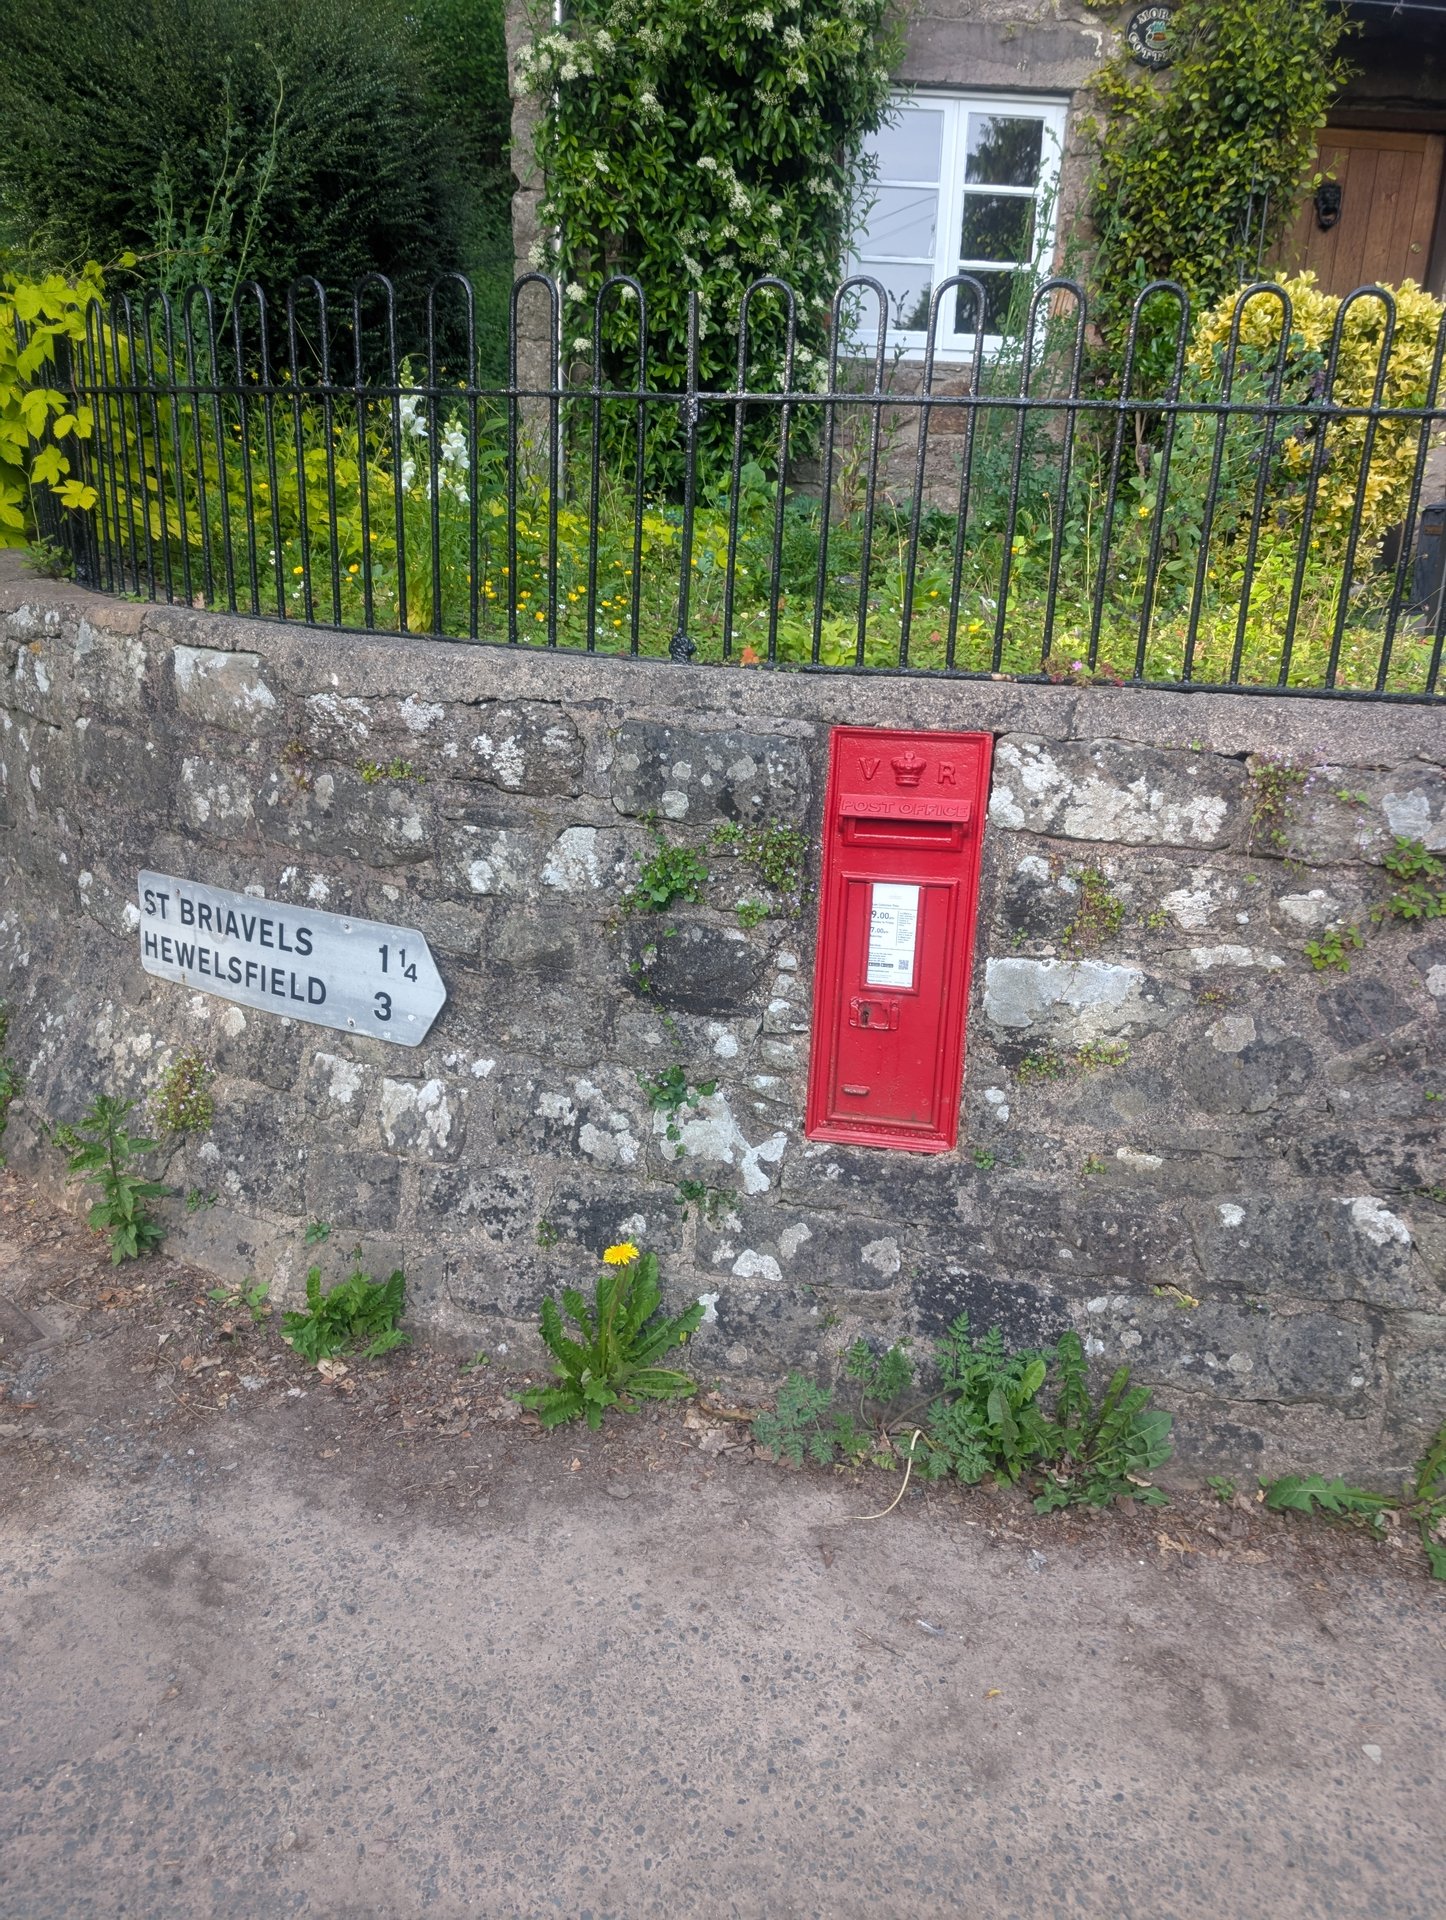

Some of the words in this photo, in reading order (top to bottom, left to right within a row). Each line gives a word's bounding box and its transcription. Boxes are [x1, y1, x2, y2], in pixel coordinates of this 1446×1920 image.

[858, 757, 880, 781] V
[937, 761, 956, 785] R
[841, 800, 895, 814] POST
[900, 803, 968, 818] OFFICE
[144, 889, 169, 919] ST
[180, 898, 313, 956] BRIAVELS
[145, 931, 327, 1005] HEWELSFIELD
[373, 991, 392, 1021] 3
